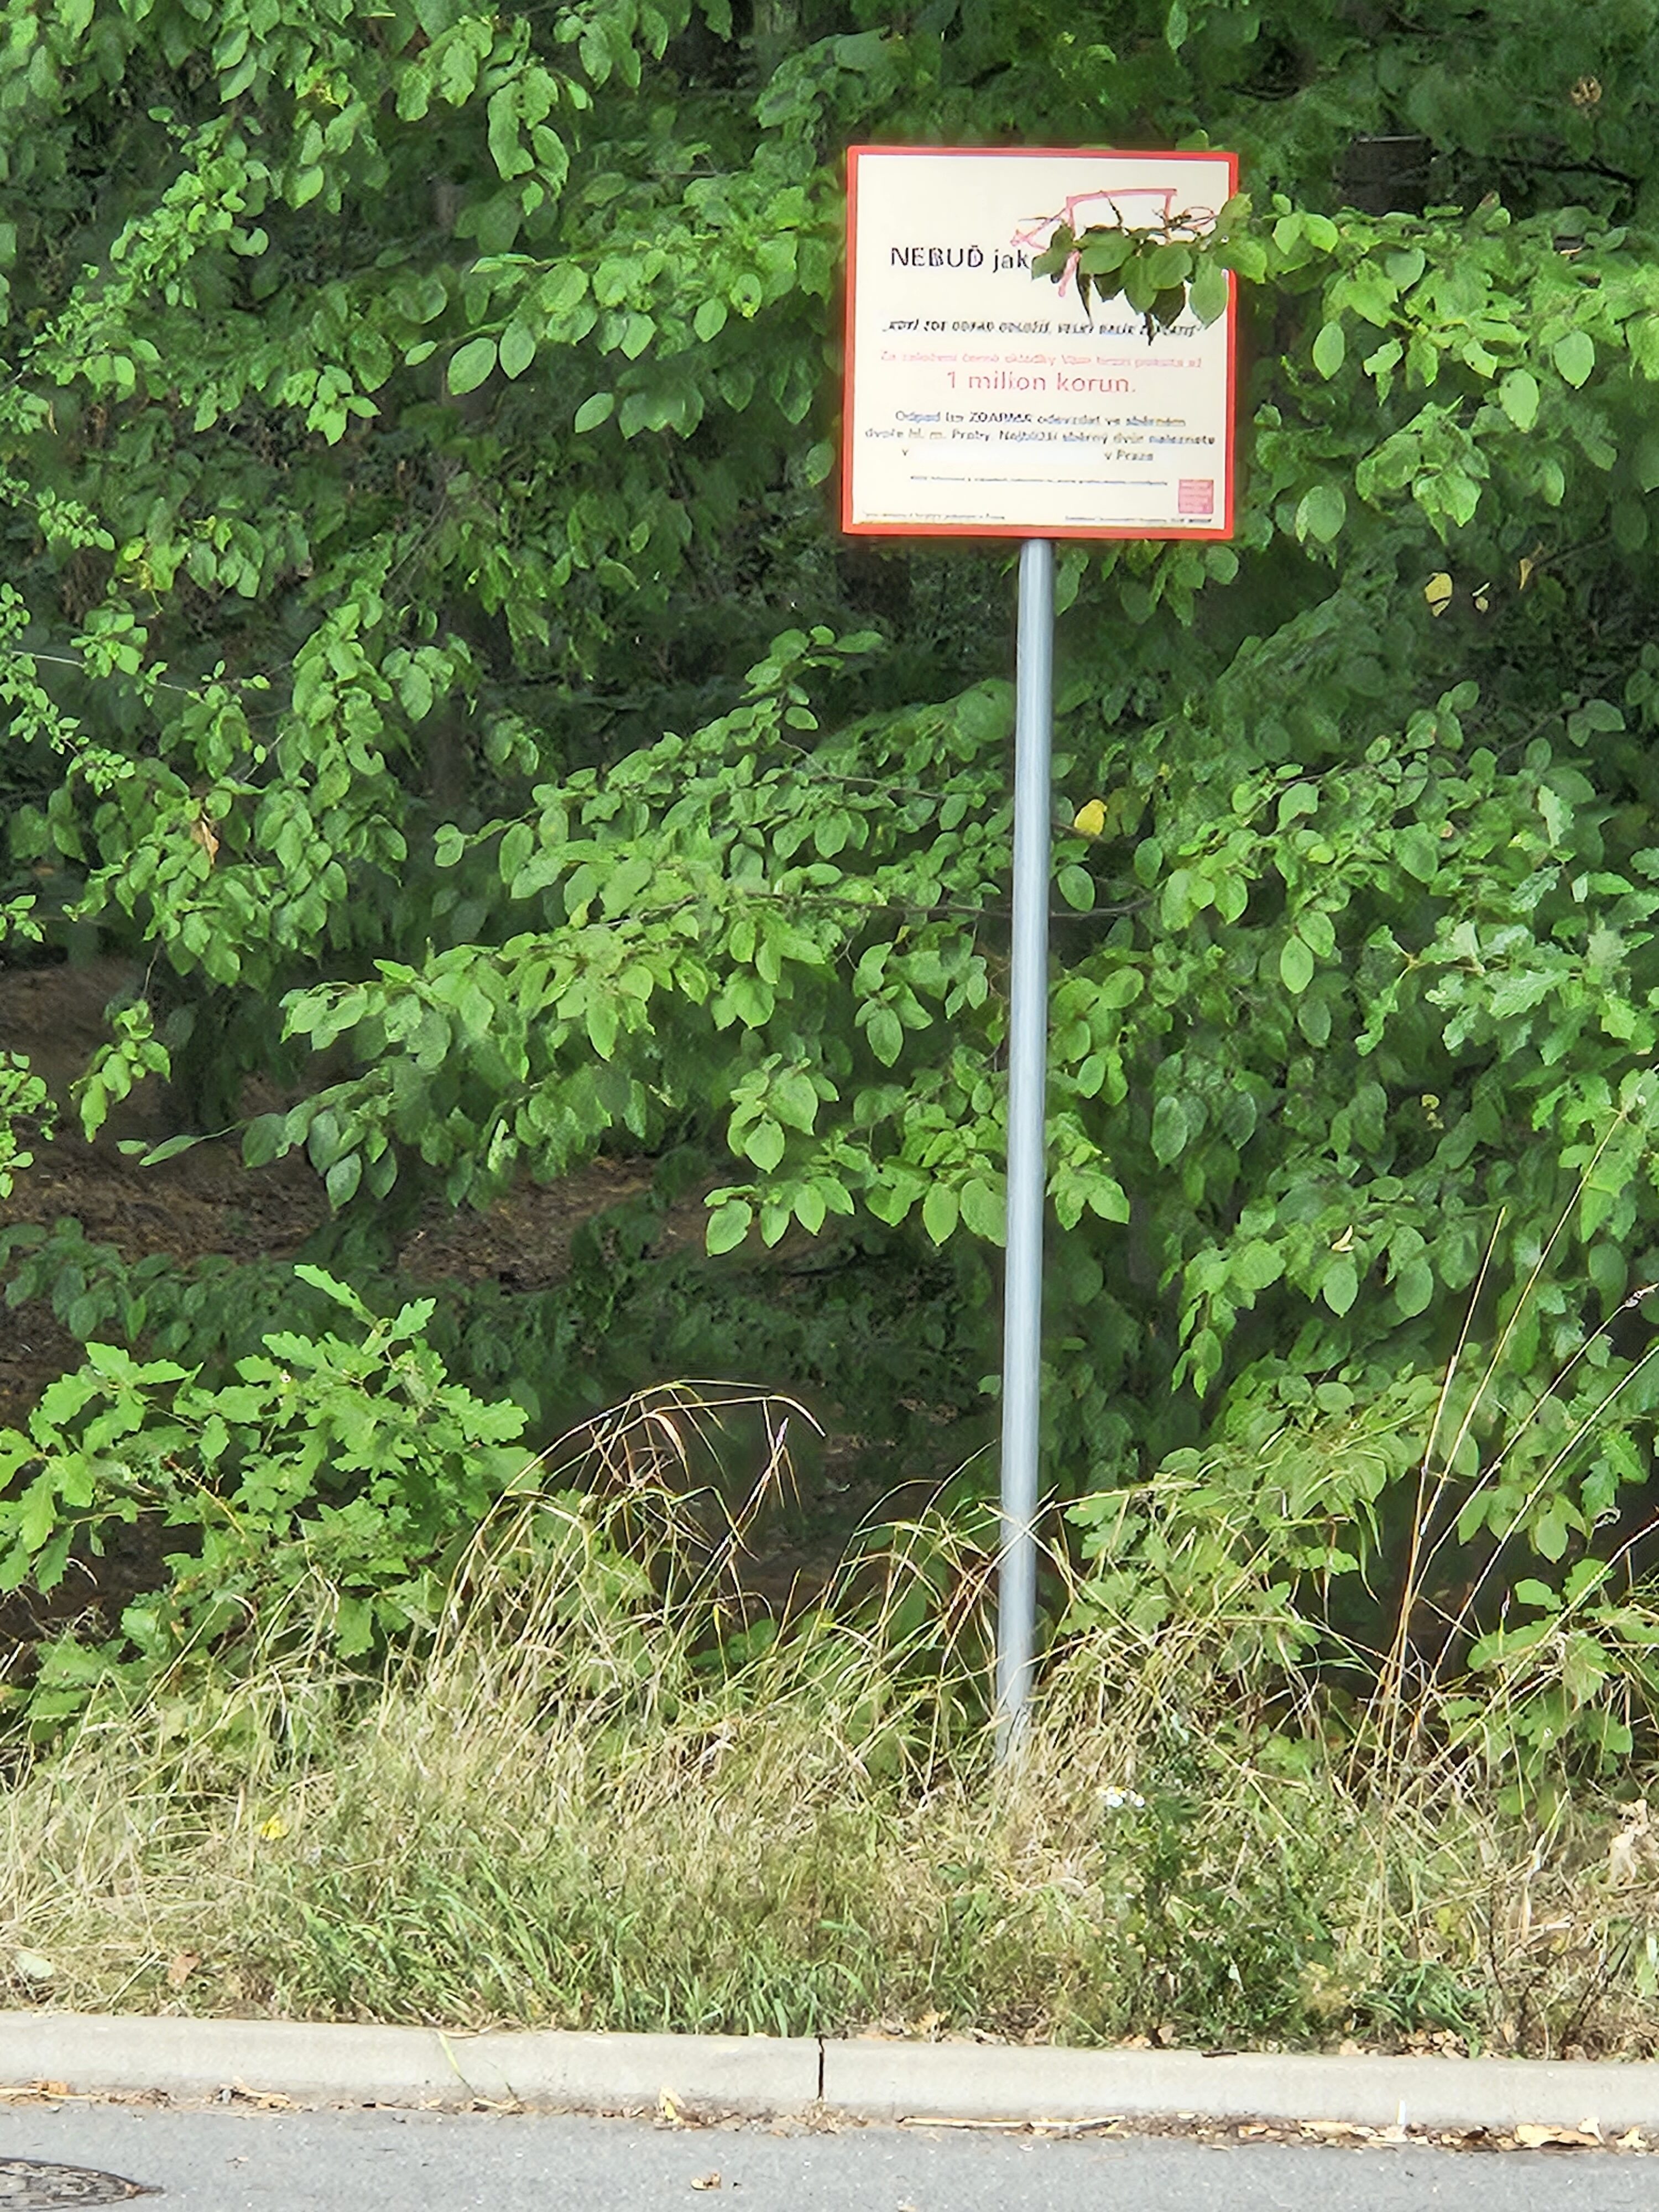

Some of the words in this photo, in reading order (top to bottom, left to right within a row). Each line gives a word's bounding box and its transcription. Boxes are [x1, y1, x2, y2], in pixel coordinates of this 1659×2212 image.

[891, 244, 984, 268] NEBUĎ
[992, 248, 1032, 274] jak
[947, 371, 956, 389] 1
[968, 370, 1046, 391] milion
[1057, 372, 1136, 393] korun.
